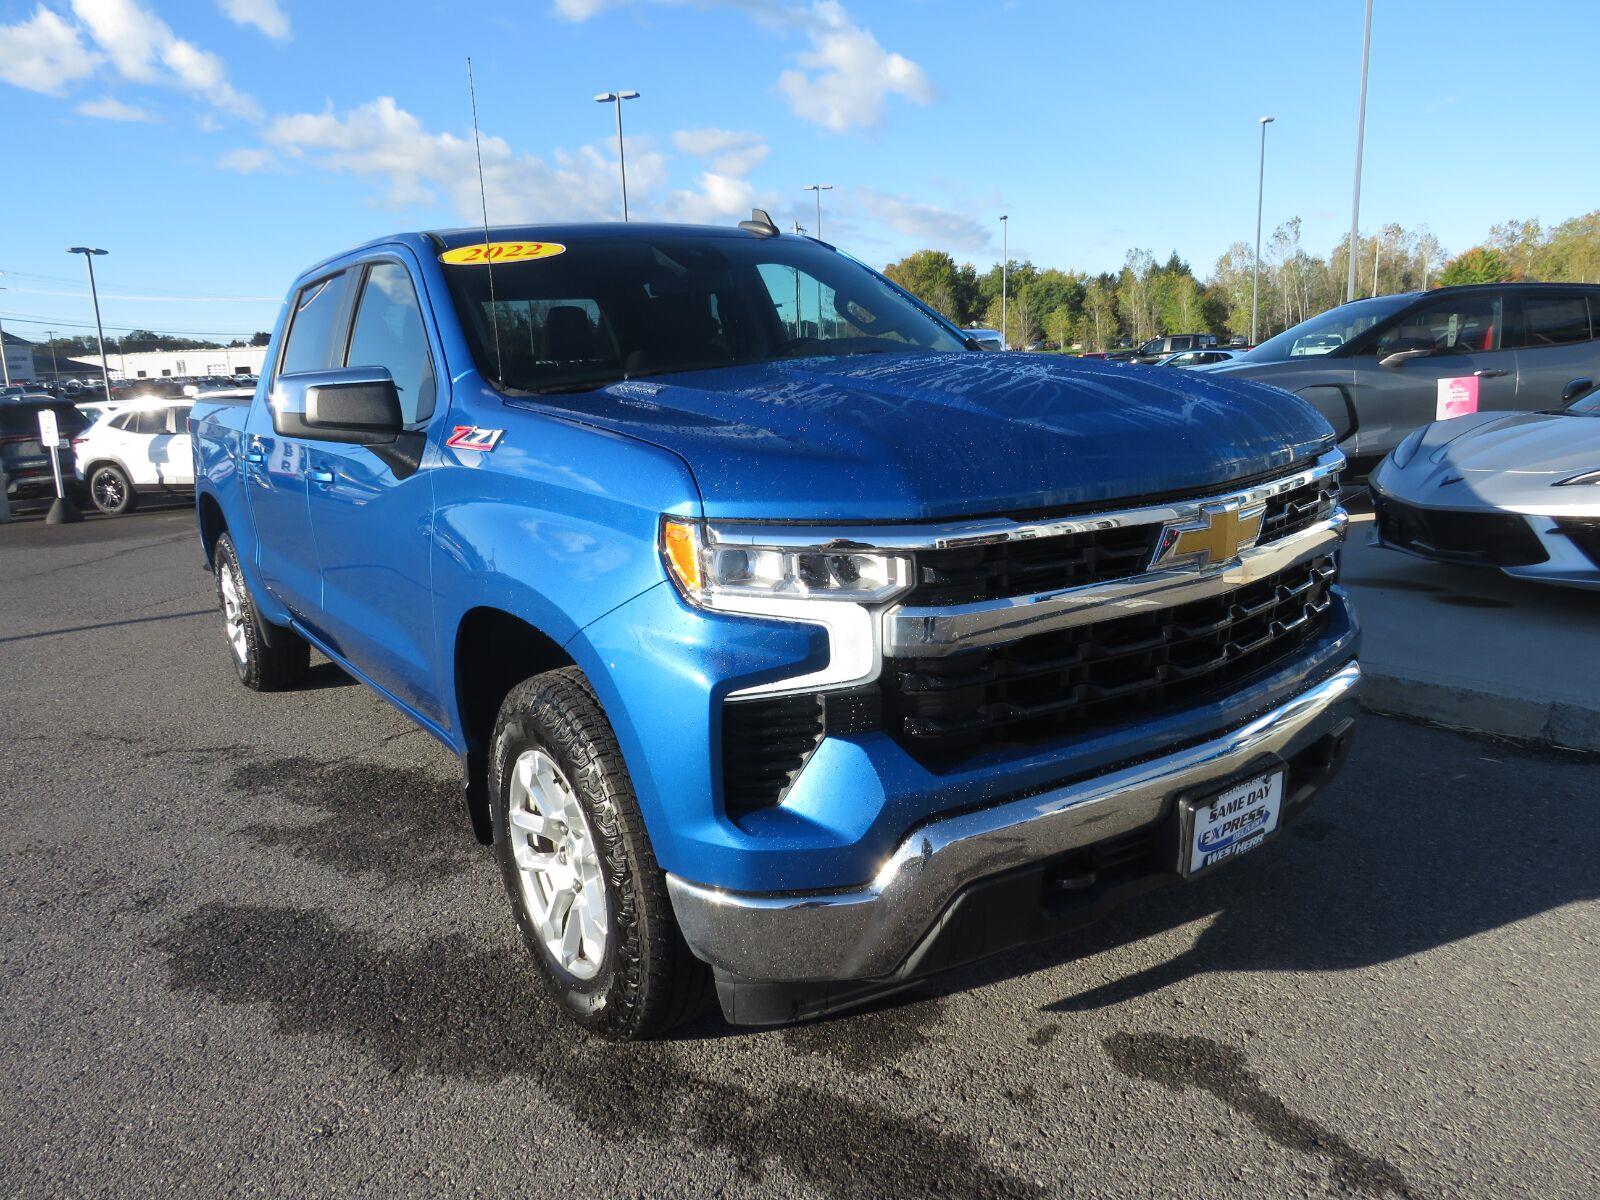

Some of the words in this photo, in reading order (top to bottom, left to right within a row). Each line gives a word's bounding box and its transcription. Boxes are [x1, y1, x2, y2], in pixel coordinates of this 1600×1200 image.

[462, 244, 543, 262] 2022
[446, 425, 503, 452] Z71
[1208, 795, 1246, 824] SAME
[1246, 783, 1272, 806] DAY
[1201, 804, 1265, 845] EXPRESS
